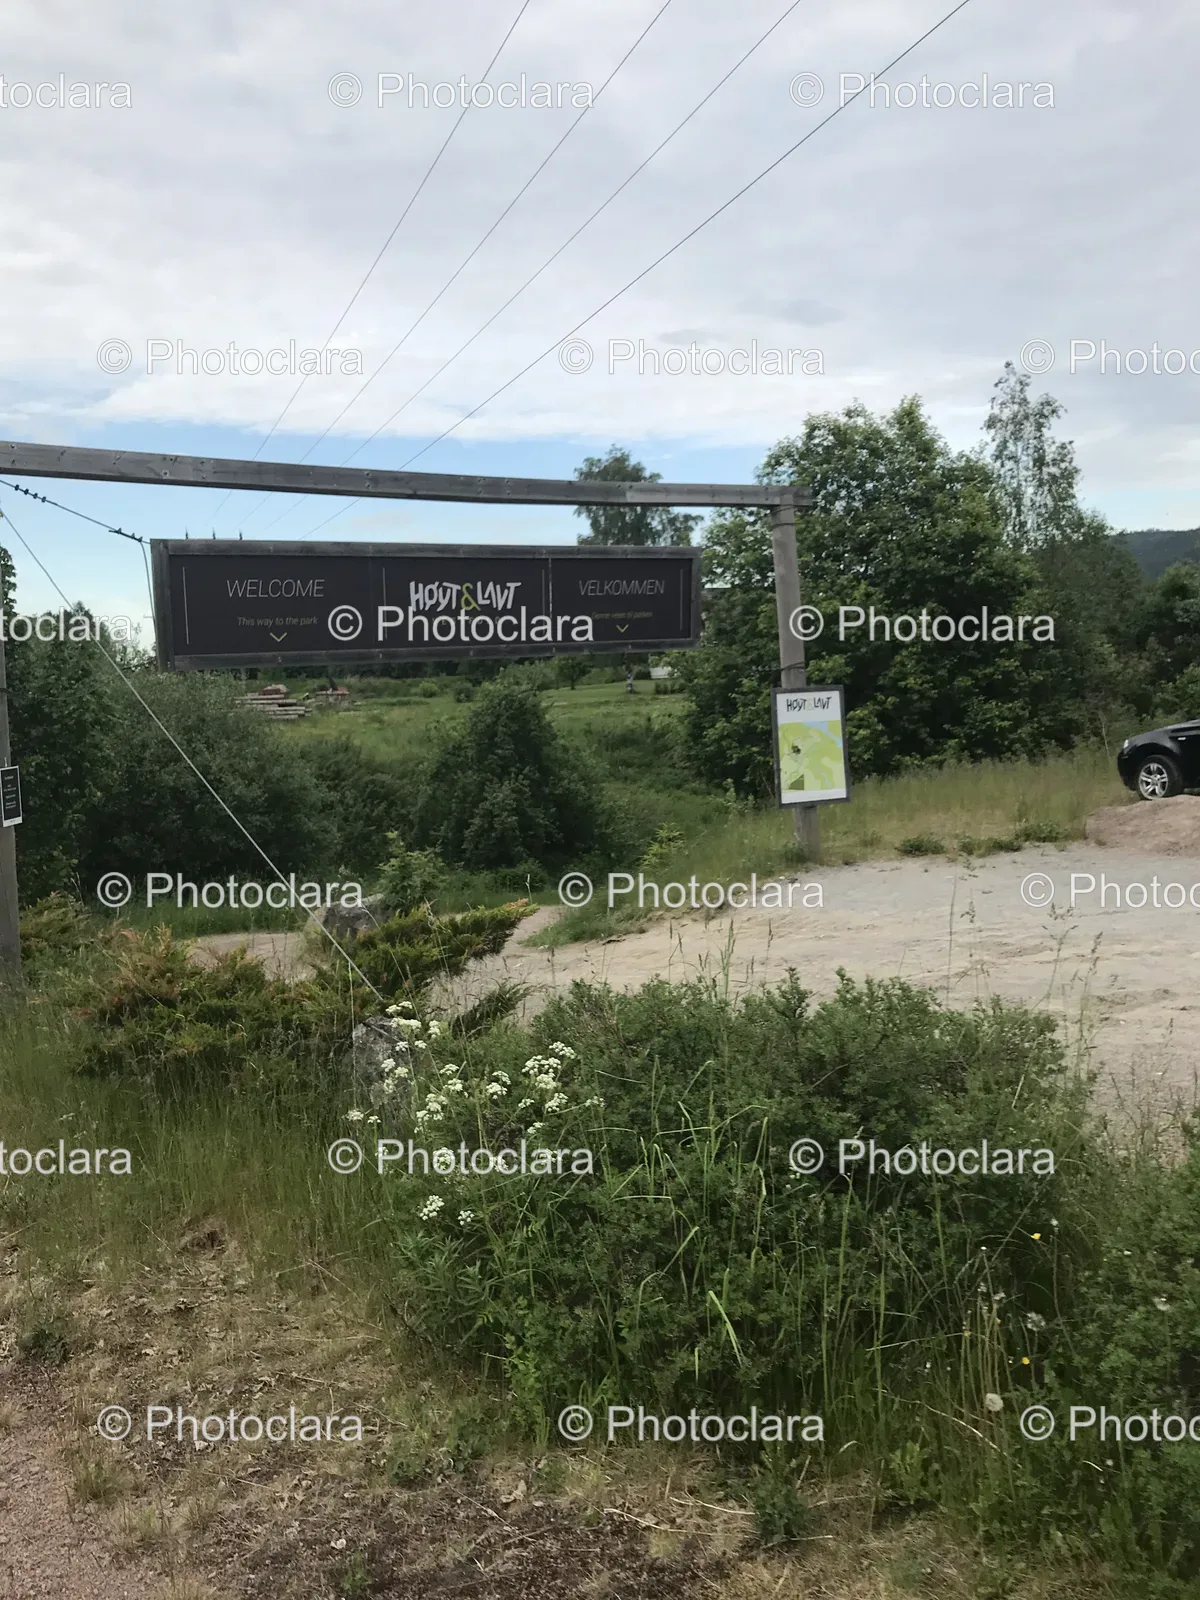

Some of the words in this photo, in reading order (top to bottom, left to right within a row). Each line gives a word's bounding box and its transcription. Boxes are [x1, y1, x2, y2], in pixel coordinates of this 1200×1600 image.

[226, 579, 326, 598] WELCOME
[578, 579, 665, 596] VELKOMMEN
[237, 616, 255, 626] This
[256, 618, 274, 629] way
[275, 616, 284, 626] to
[285, 616, 299, 625] the
[300, 615, 320, 626] park
